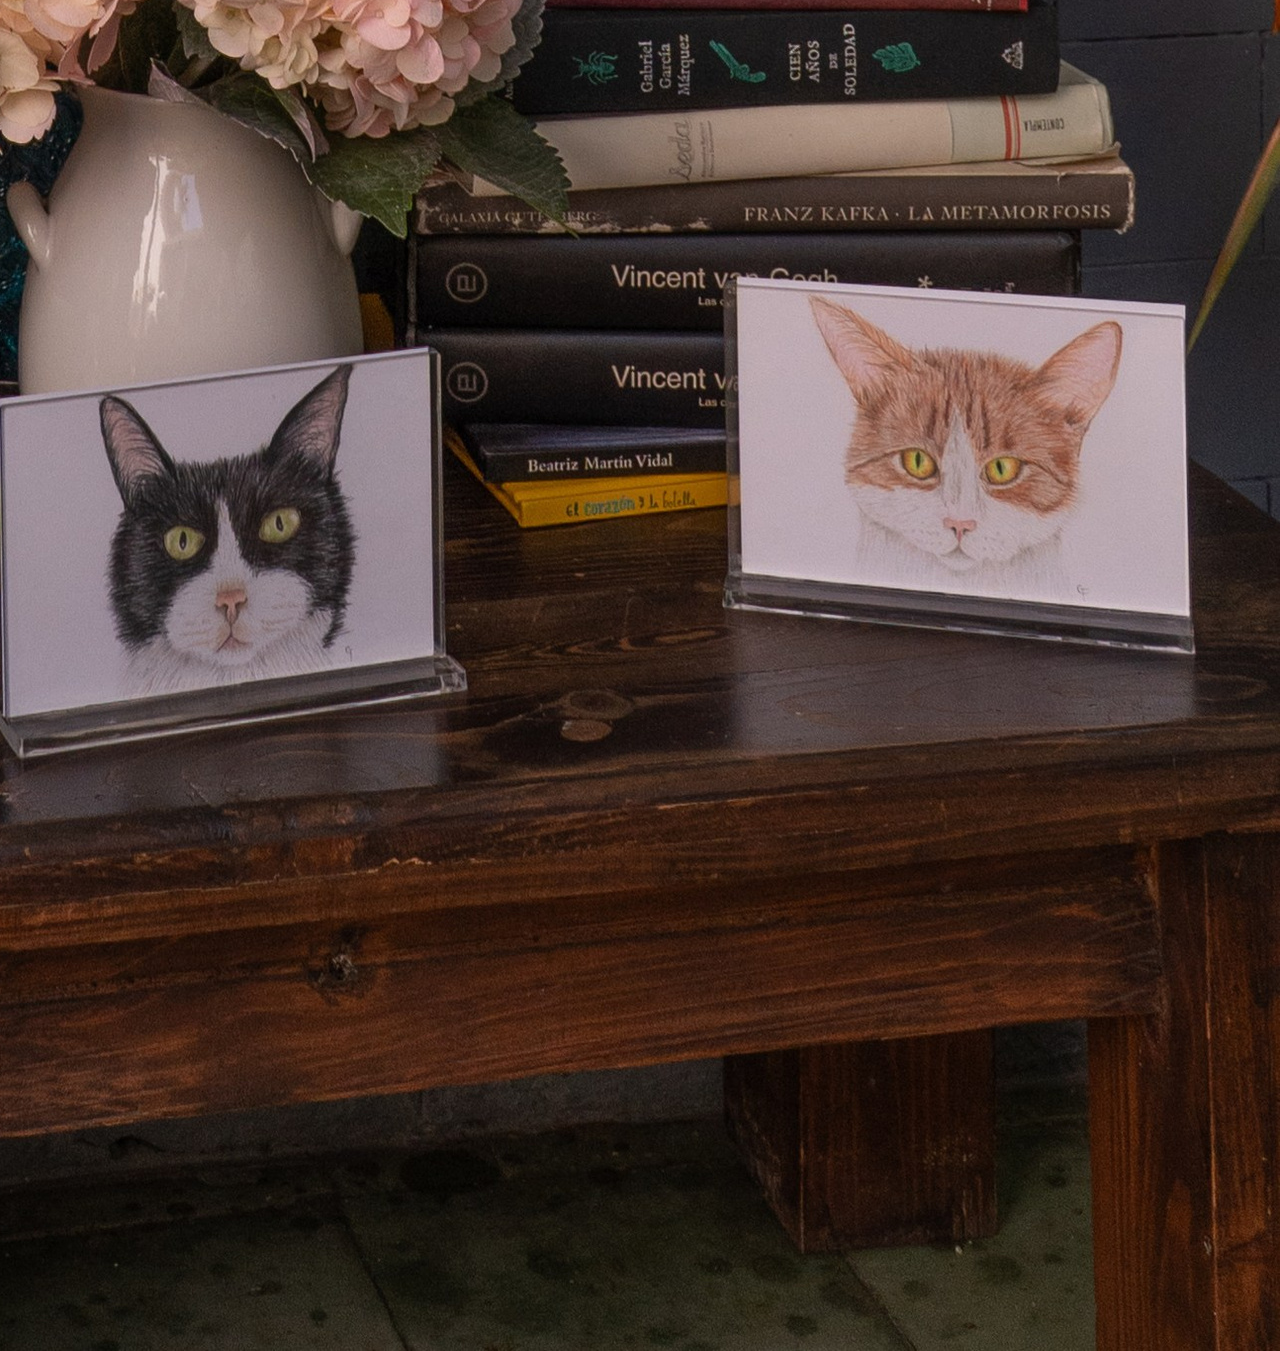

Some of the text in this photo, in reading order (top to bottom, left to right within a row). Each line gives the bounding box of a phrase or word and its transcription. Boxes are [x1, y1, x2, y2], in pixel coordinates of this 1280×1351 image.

[639, 39, 654, 93] Gabriel
[659, 42, 672, 89] García
[677, 34, 696, 96] Márquez
[788, 43, 801, 81] CIEN
[807, 39, 820, 83] AÑOS
[844, 23, 857, 96] SOLEDAD
[744, 204, 1112, 222] FRANZ KAFKA METAMORFOSIS
[611, 264, 706, 290] Vincent
[611, 364, 707, 391] Vincent
[528, 453, 673, 473] Beatriz Martín Vidal
[583, 496, 636, 516] corazón
